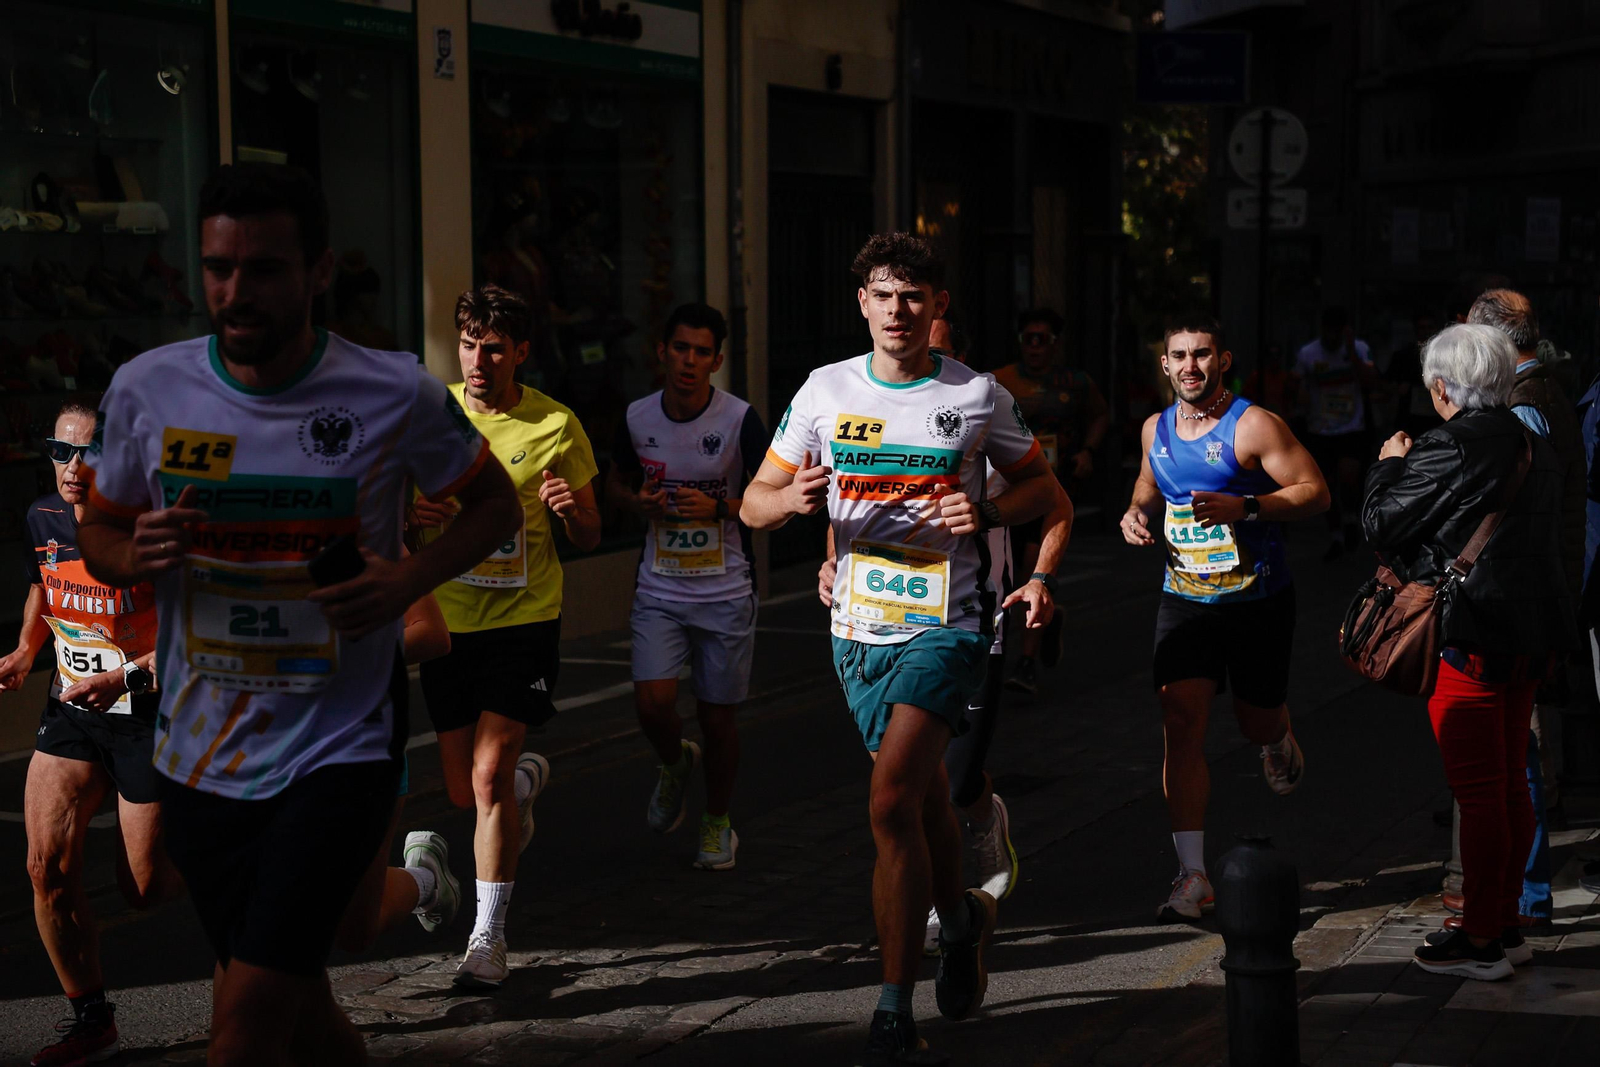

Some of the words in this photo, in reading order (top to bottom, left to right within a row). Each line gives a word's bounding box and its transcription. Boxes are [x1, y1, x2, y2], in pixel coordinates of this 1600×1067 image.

[834, 452, 948, 469] CARRERA
[164, 486, 333, 509] CRRERA
[666, 530, 709, 548] 710
[1170, 524, 1226, 543] 1154
[46, 575, 61, 589] Club
[63, 580, 116, 597] Deportivo
[866, 569, 928, 599] 646
[61, 588, 136, 615] ZUBIA
[229, 605, 289, 637] 21
[63, 646, 108, 673] 651
